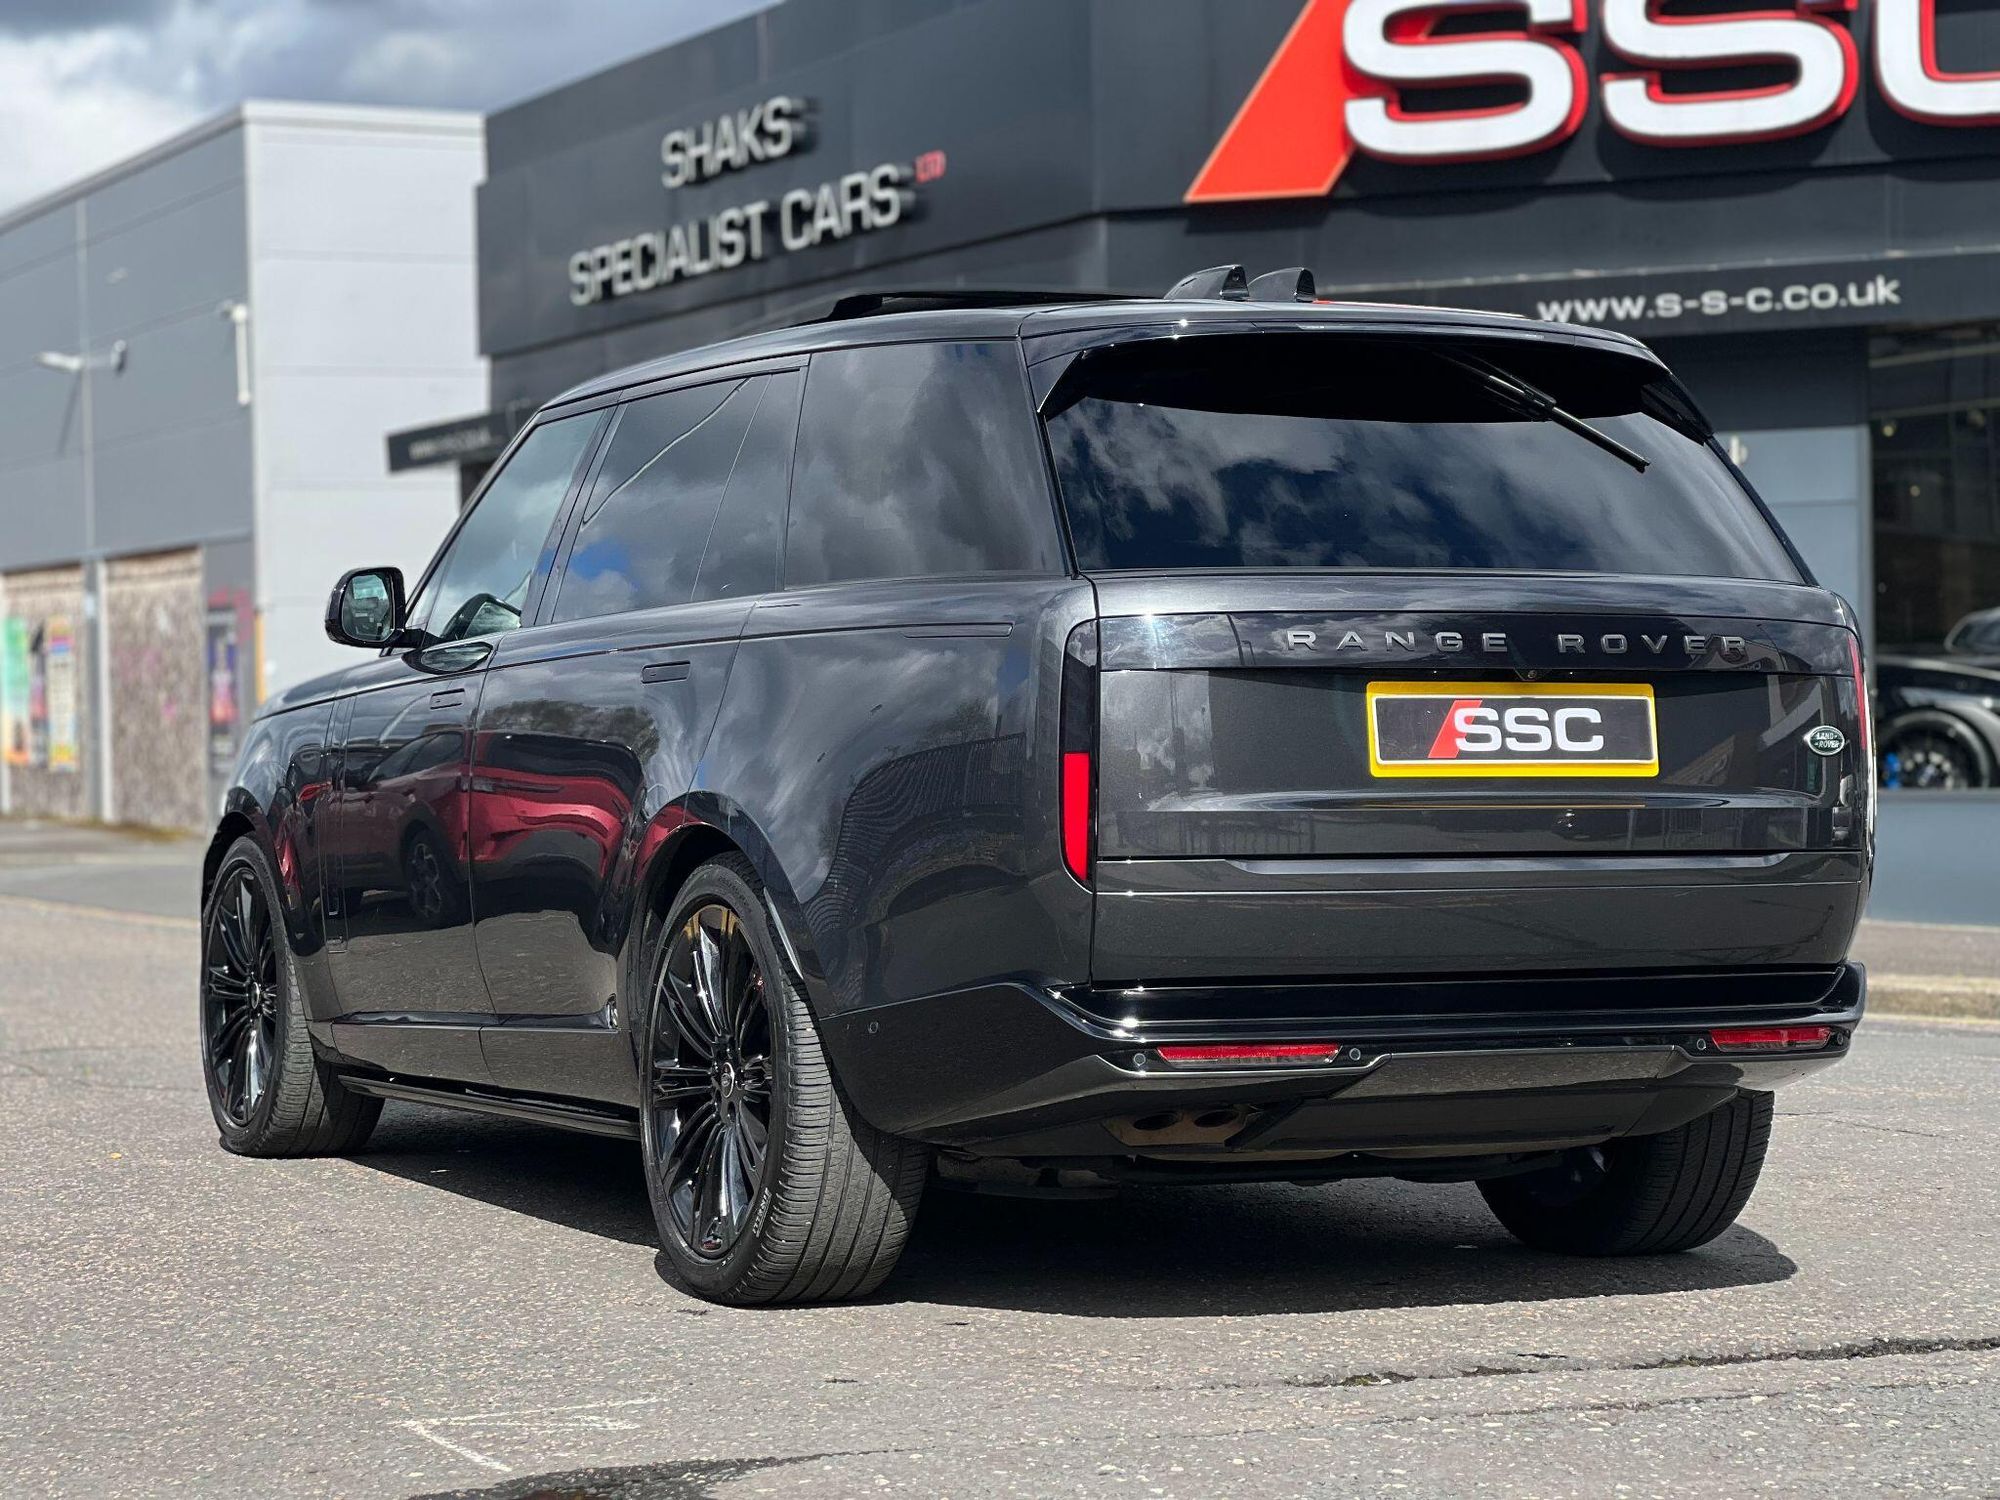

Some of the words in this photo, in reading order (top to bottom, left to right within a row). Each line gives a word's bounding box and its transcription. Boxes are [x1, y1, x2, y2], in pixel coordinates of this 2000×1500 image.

[661, 96, 794, 188] SHAKS
[569, 202, 769, 306] SPECIALIST
[780, 163, 902, 252] CARS
[1537, 274, 1901, 323] www.s-s-c.co.uk
[1286, 630, 1508, 653] RANGE
[1557, 633, 1747, 655] ROVER
[1454, 707, 1604, 752] SSC
[1815, 732, 1834, 740] LAND
[1818, 739, 1840, 748] ROVER
